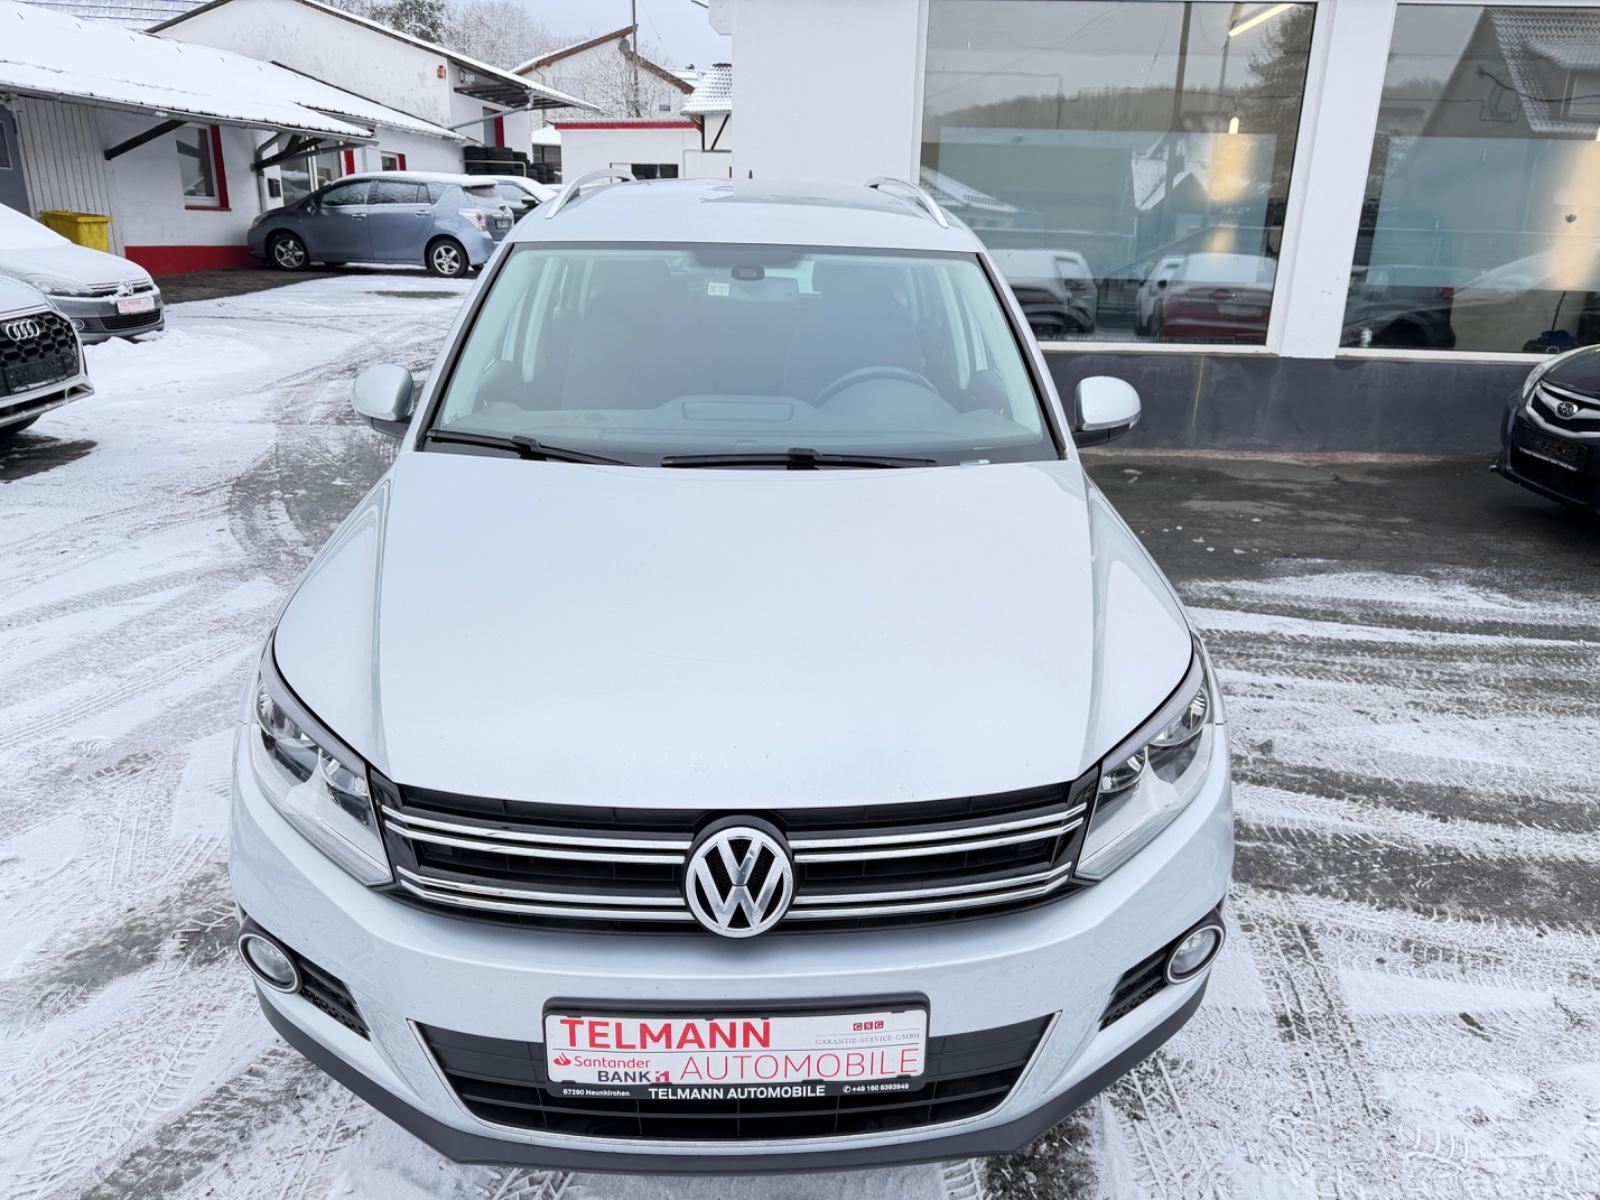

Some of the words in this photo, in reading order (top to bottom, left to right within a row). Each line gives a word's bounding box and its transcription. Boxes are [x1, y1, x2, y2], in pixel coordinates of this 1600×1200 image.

[560, 1018, 771, 1049] TELMANN
[574, 1055, 650, 1069] Santander
[679, 1048, 919, 1081] AUTOMOBILE
[597, 1070, 651, 1083] BANK
[648, 1088, 724, 1100] TELMANN
[727, 1085, 826, 1099] AUTOMOBILE
